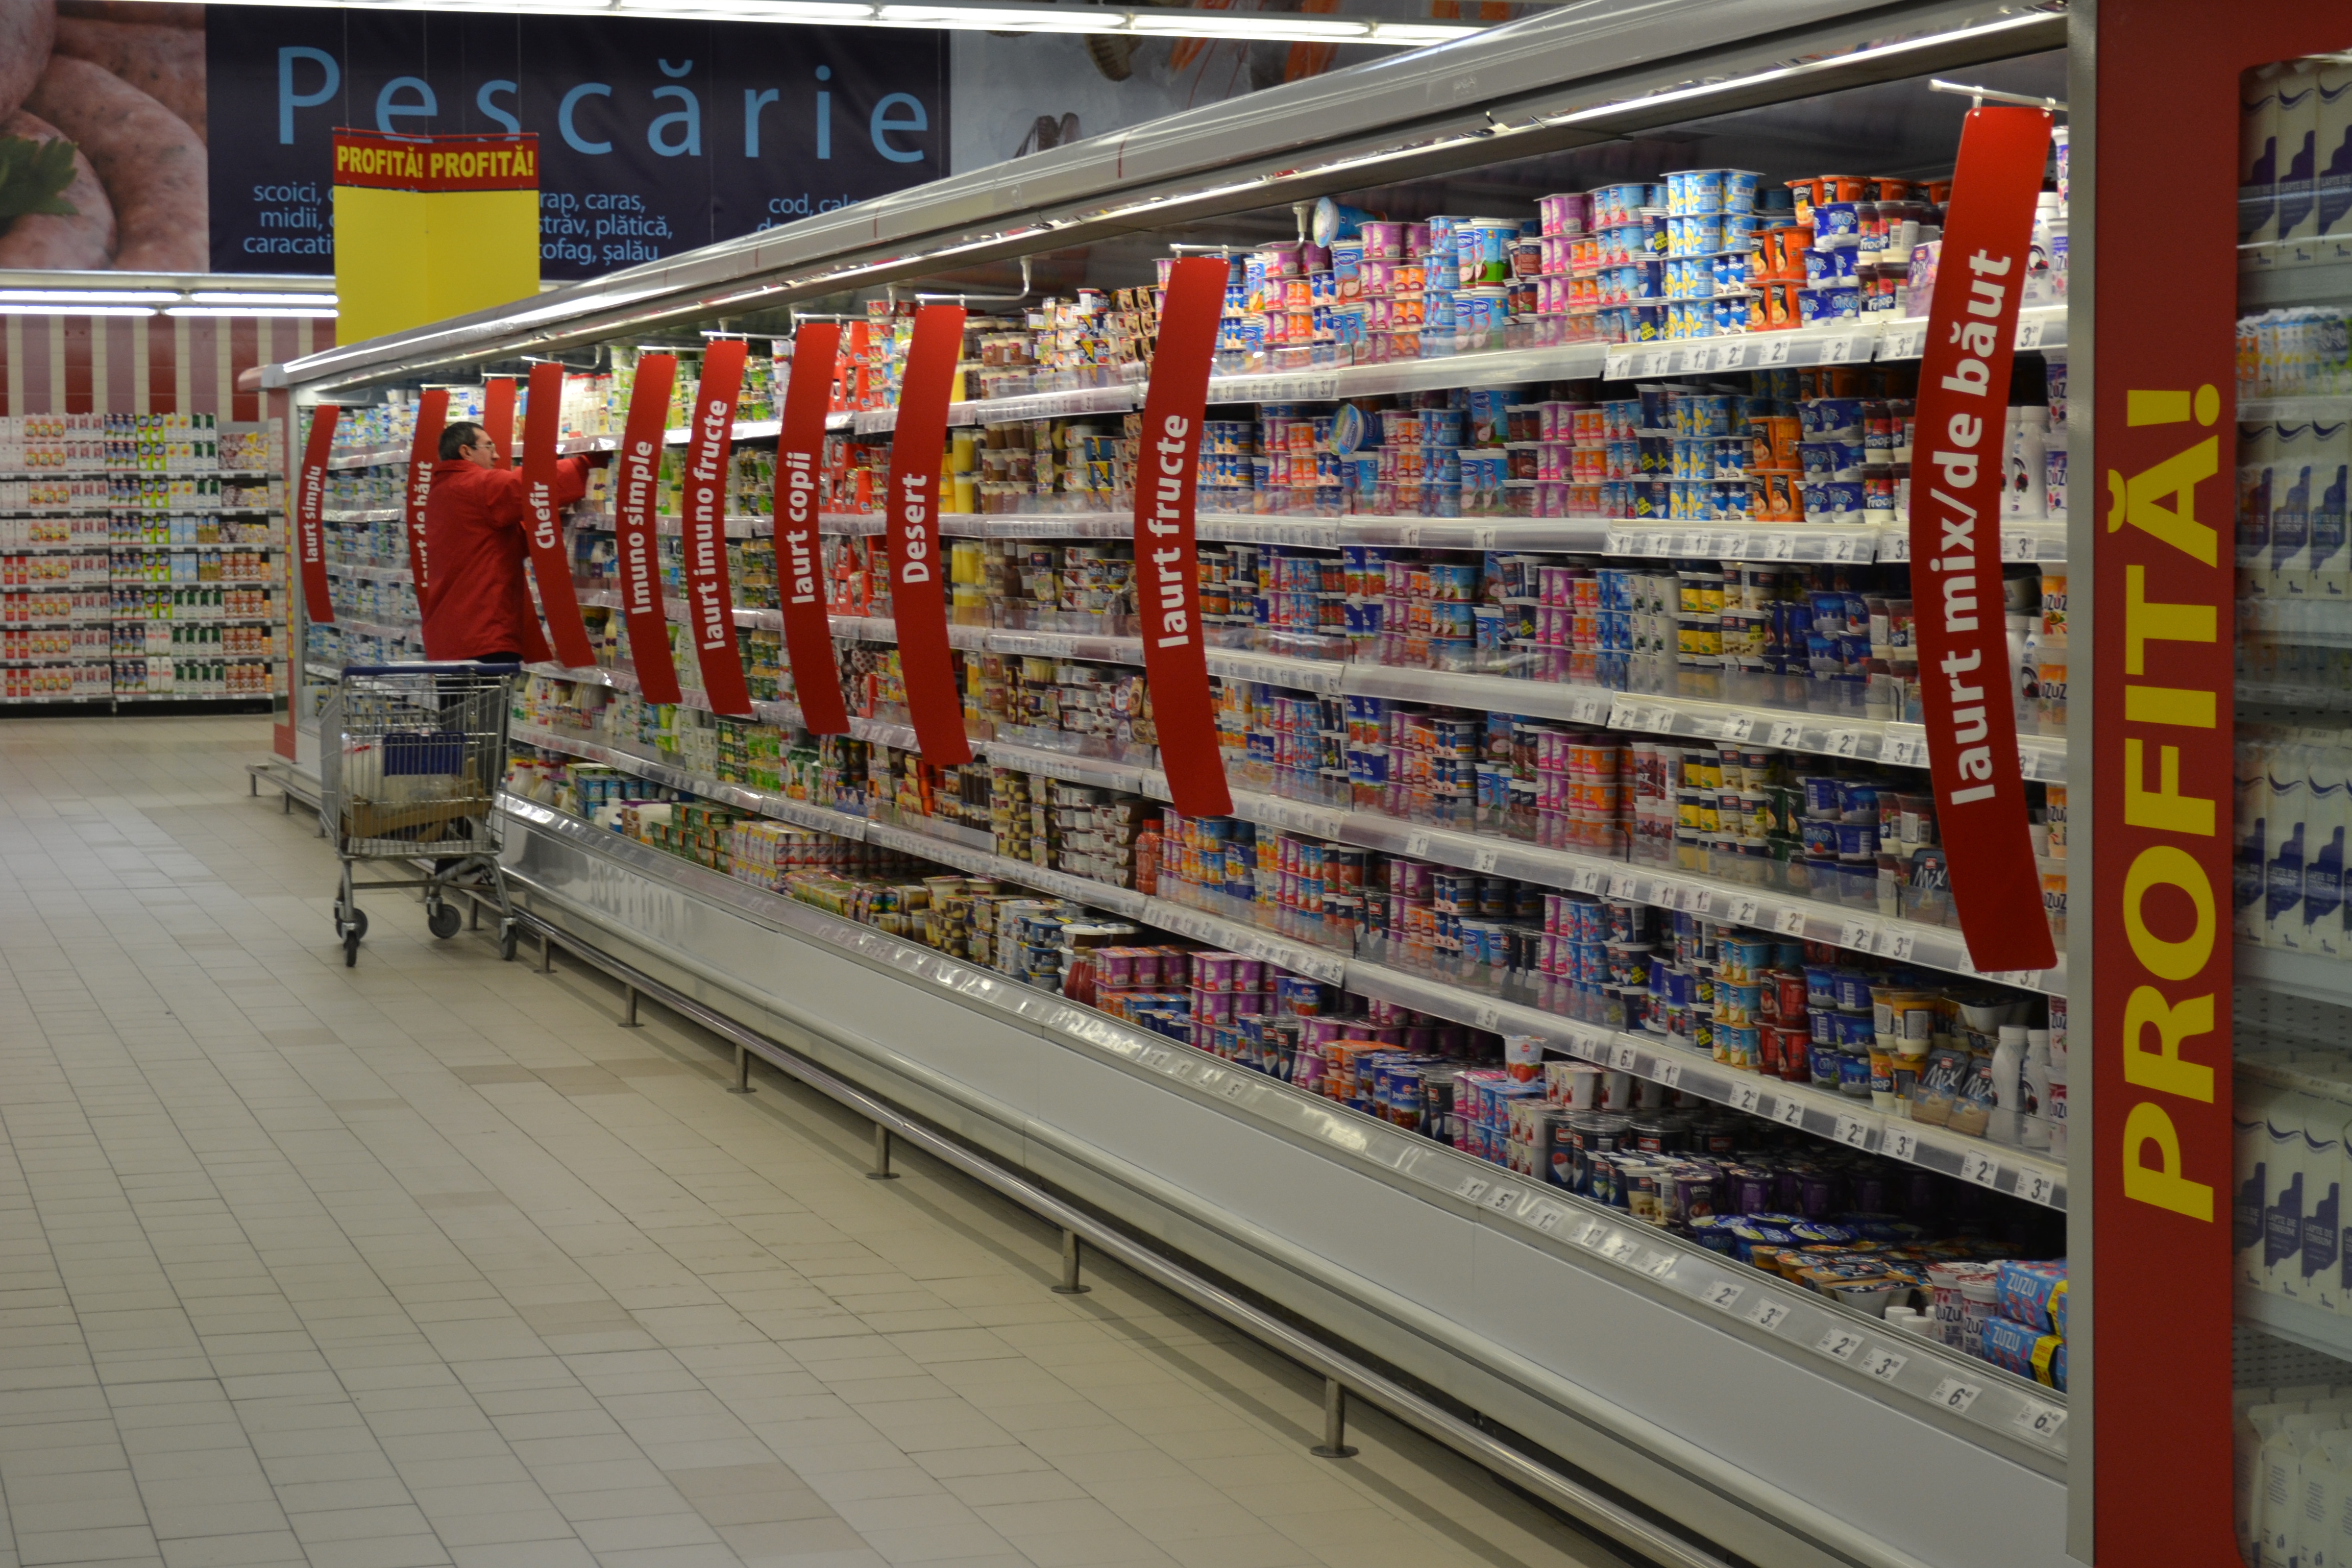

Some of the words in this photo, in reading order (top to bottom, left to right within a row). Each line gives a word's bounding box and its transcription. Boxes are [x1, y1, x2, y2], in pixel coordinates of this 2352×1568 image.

[279, 47, 927, 163] Pescărie
[337, 145, 423, 178] PROFITĂ!
[431, 145, 533, 178] PROFITĂ!
[253, 182, 322, 206] scoici,
[585, 194, 646, 213] caras,
[769, 193, 814, 216] cod,
[260, 206, 323, 231] midii,
[596, 214, 673, 240] plătică,
[243, 234, 335, 254] caracati
[1941, 249, 2011, 397] băut
[693, 400, 727, 481] fructe
[623, 442, 653, 525] simple
[786, 452, 815, 522] copii
[1147, 415, 1188, 537] fructe
[305, 465, 322, 518] simplu
[531, 482, 555, 549] Chefir
[902, 473, 930, 583] Desert
[1930, 413, 1982, 633] mix/de
[305, 521, 319, 562] Iaurt
[693, 488, 716, 576] imuno
[628, 532, 652, 614] Imuno
[786, 530, 815, 604] Iaurt
[1152, 547, 1189, 648] Iaurt
[697, 582, 725, 650] Iaurt
[1941, 649, 1996, 805] Iaurt
[2108, 384, 2220, 1222] PROFITĂ!
[1922, 1064, 1963, 1090] Mix
[1742, 1090, 1751, 1108] 2
[1785, 1104, 1795, 1122] 2
[1847, 1123, 1857, 1142] 2
[1897, 1136, 1906, 1156] 3
[1976, 1161, 1988, 1182] 2
[2031, 1178, 2042, 1199] 3
[1714, 1288, 1731, 1303] 2
[2006, 1272, 2038, 1297] ZUZU
[1761, 1308, 1776, 1324] 3
[1831, 1337, 1850, 1354] 2
[1992, 1326, 2021, 1352] ZUZU
[1875, 1358, 1892, 1375] 3
[1948, 1388, 1966, 1406] 6
[2034, 1410, 2052, 1429] 6
